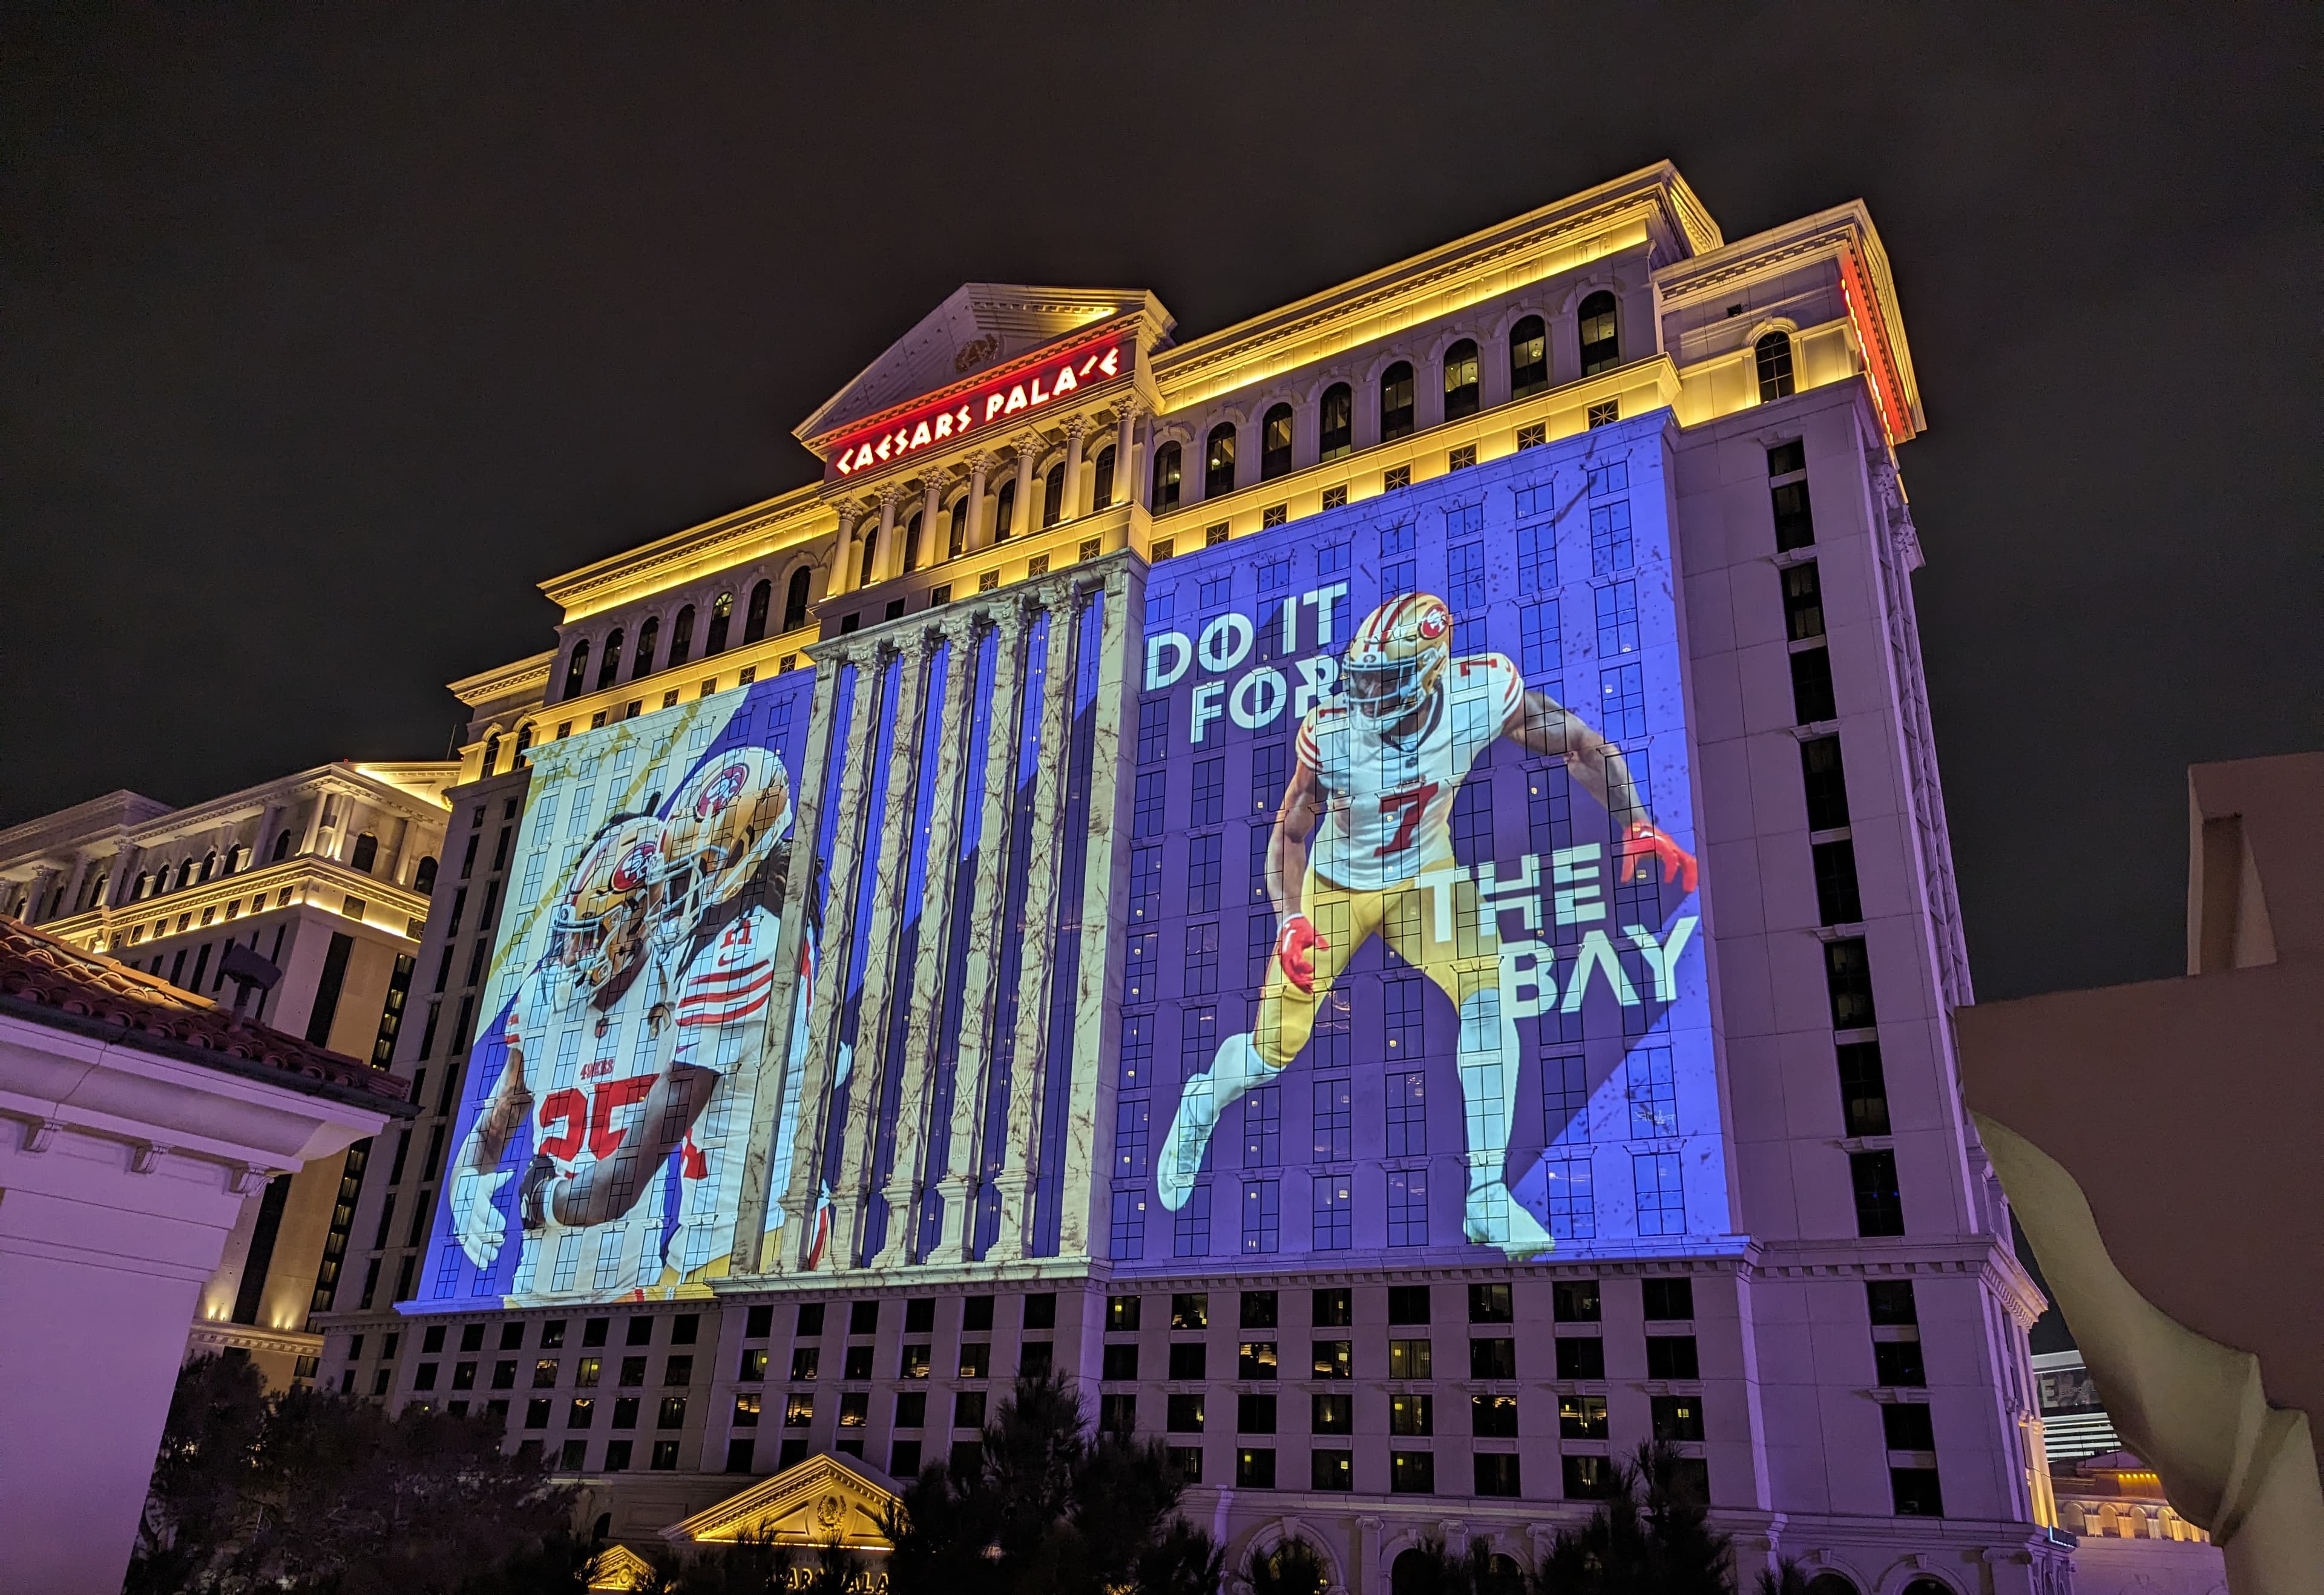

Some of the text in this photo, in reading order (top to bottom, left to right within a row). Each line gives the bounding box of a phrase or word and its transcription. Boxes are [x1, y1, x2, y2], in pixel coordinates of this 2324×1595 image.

[836, 404, 971, 475] CAESARS
[1146, 582, 1347, 691] DO IT
[1190, 655, 1340, 743] FOR
[1373, 781, 1439, 857] 7
[1414, 842, 1606, 943] THE
[1498, 915, 1699, 1019] BAY
[580, 1059, 614, 1080] 49ERS
